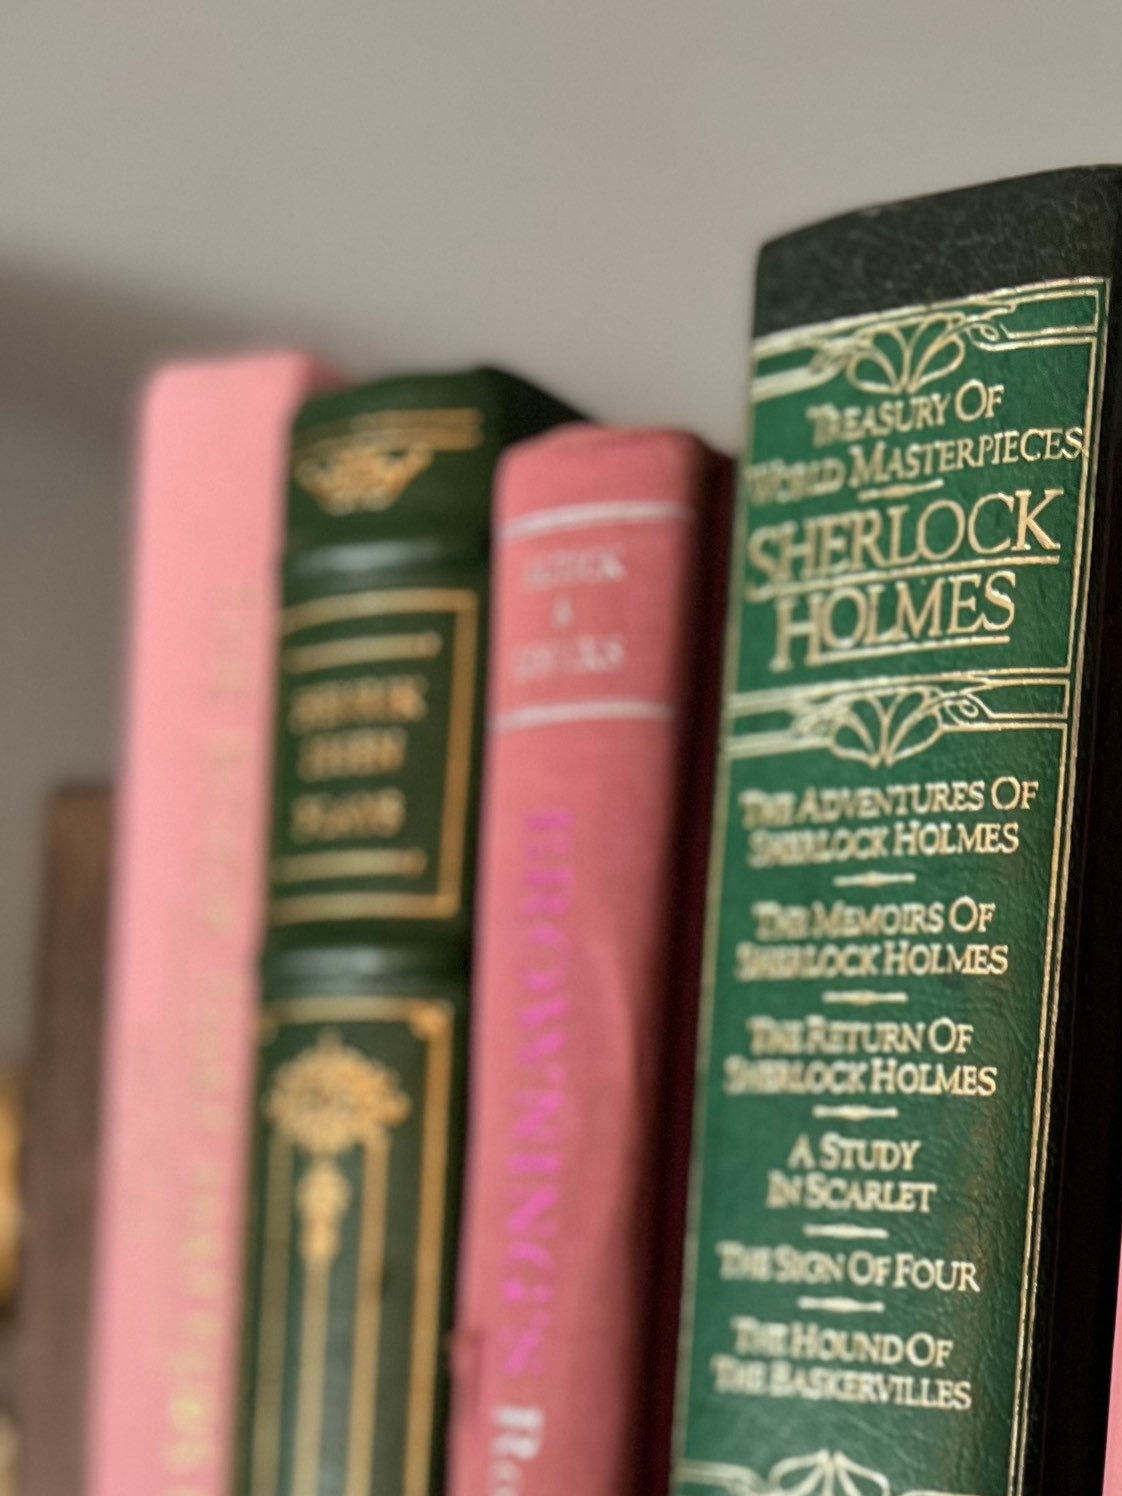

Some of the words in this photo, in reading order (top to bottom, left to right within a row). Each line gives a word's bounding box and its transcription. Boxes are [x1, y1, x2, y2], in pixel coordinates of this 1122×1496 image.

[954, 379, 1005, 423] OF
[849, 426, 1088, 488] MASTERPIECES
[745, 488, 1064, 602] SHERLOCK
[769, 570, 1016, 672] HOLMES
[799, 780, 986, 823] ADVENTURES
[990, 776, 1040, 811] OF
[892, 820, 1020, 857] HOLMES
[812, 900, 945, 936] MEMOIRS
[949, 895, 996, 932] OF
[884, 940, 1009, 976] HOLMES
[805, 1013, 926, 1054] RETURN
[928, 1017, 974, 1053] OF
[870, 1056, 997, 1096] HOLMES
[788, 1132, 818, 1169] A
[820, 1131, 922, 1171] STUDY
[804, 1171, 938, 1212] SCARLET
[848, 1251, 892, 1286] OF
[892, 1253, 981, 1292] FOUR
[790, 1321, 903, 1364] HOUND
[905, 1332, 954, 1368] OF
[769, 1360, 972, 1410] BASKERVILLES
